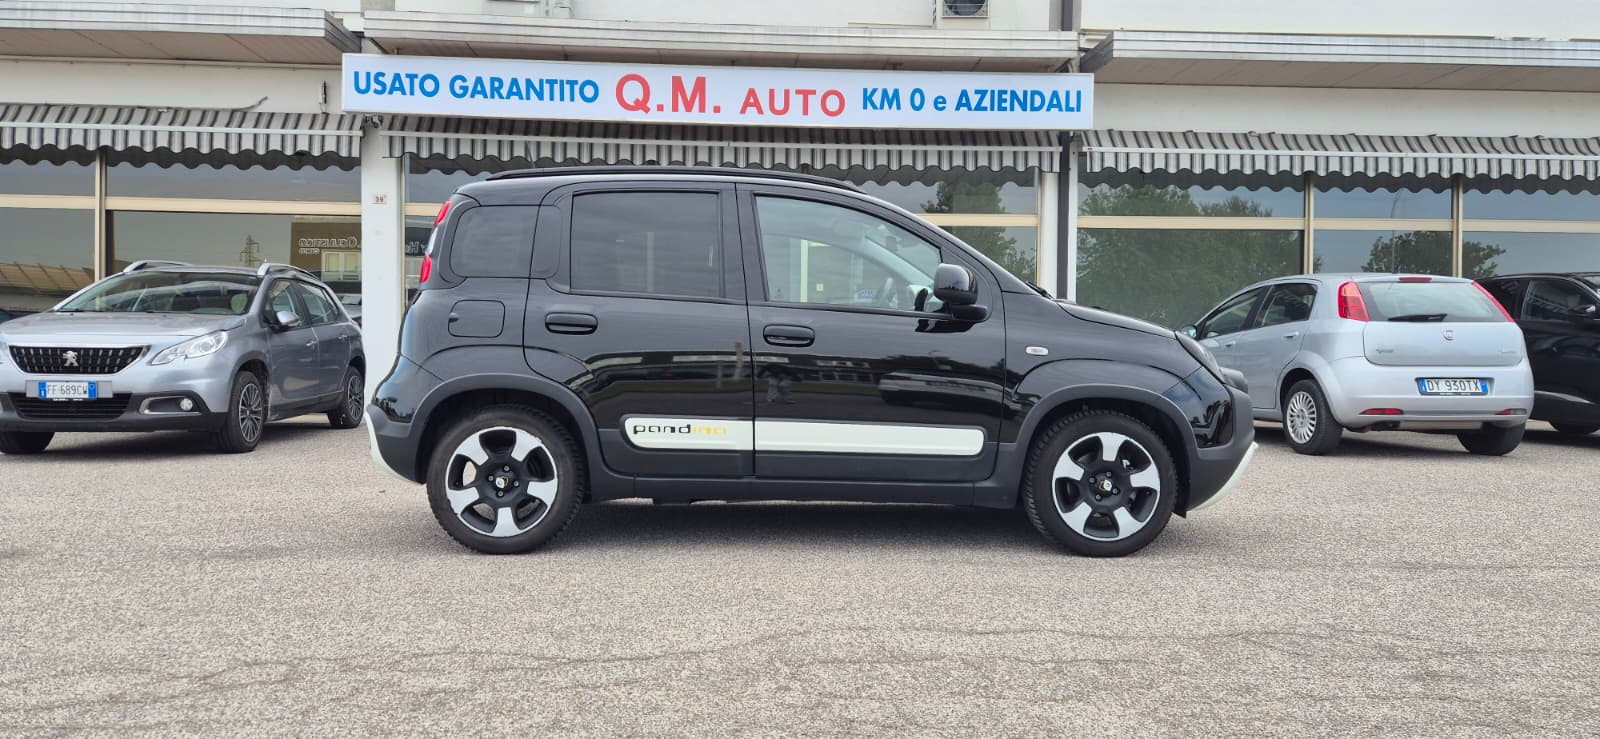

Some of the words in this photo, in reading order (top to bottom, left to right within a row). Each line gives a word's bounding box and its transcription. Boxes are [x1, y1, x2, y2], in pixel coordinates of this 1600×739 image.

[353, 70, 441, 98] USATO
[449, 74, 600, 104] GARANTITO
[615, 73, 722, 115] Q.M.
[739, 87, 847, 118] AUTO
[862, 87, 902, 112] KM
[909, 87, 926, 113] 0
[932, 95, 948, 113] e
[954, 88, 1083, 113] AZIENDALI
[1426, 379, 1440, 392] DY
[1445, 379, 1481, 392] 930TX
